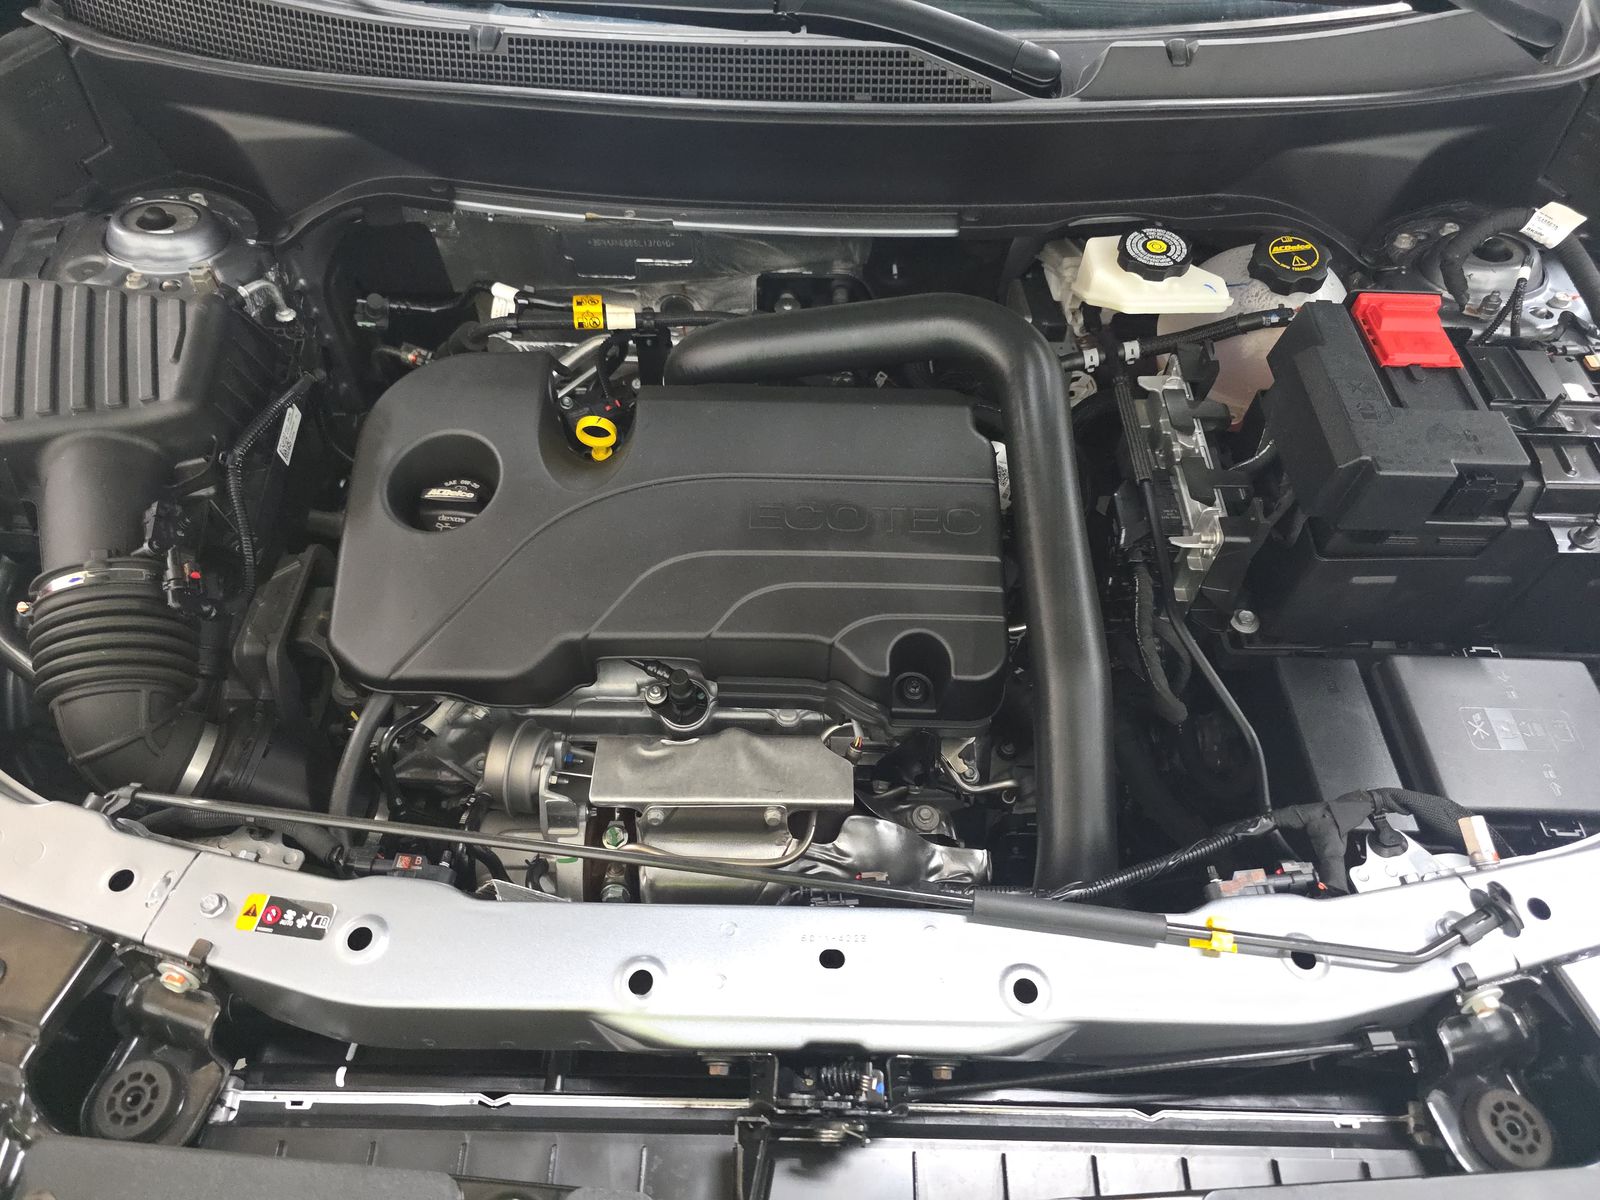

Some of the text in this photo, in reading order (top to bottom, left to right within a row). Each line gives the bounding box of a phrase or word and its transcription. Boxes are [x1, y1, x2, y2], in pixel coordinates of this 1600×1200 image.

[1272, 243, 1312, 253] ACDelco
[438, 514, 466, 523] dexos
[747, 503, 983, 536] ECOTEC
[414, 855, 423, 865] B
